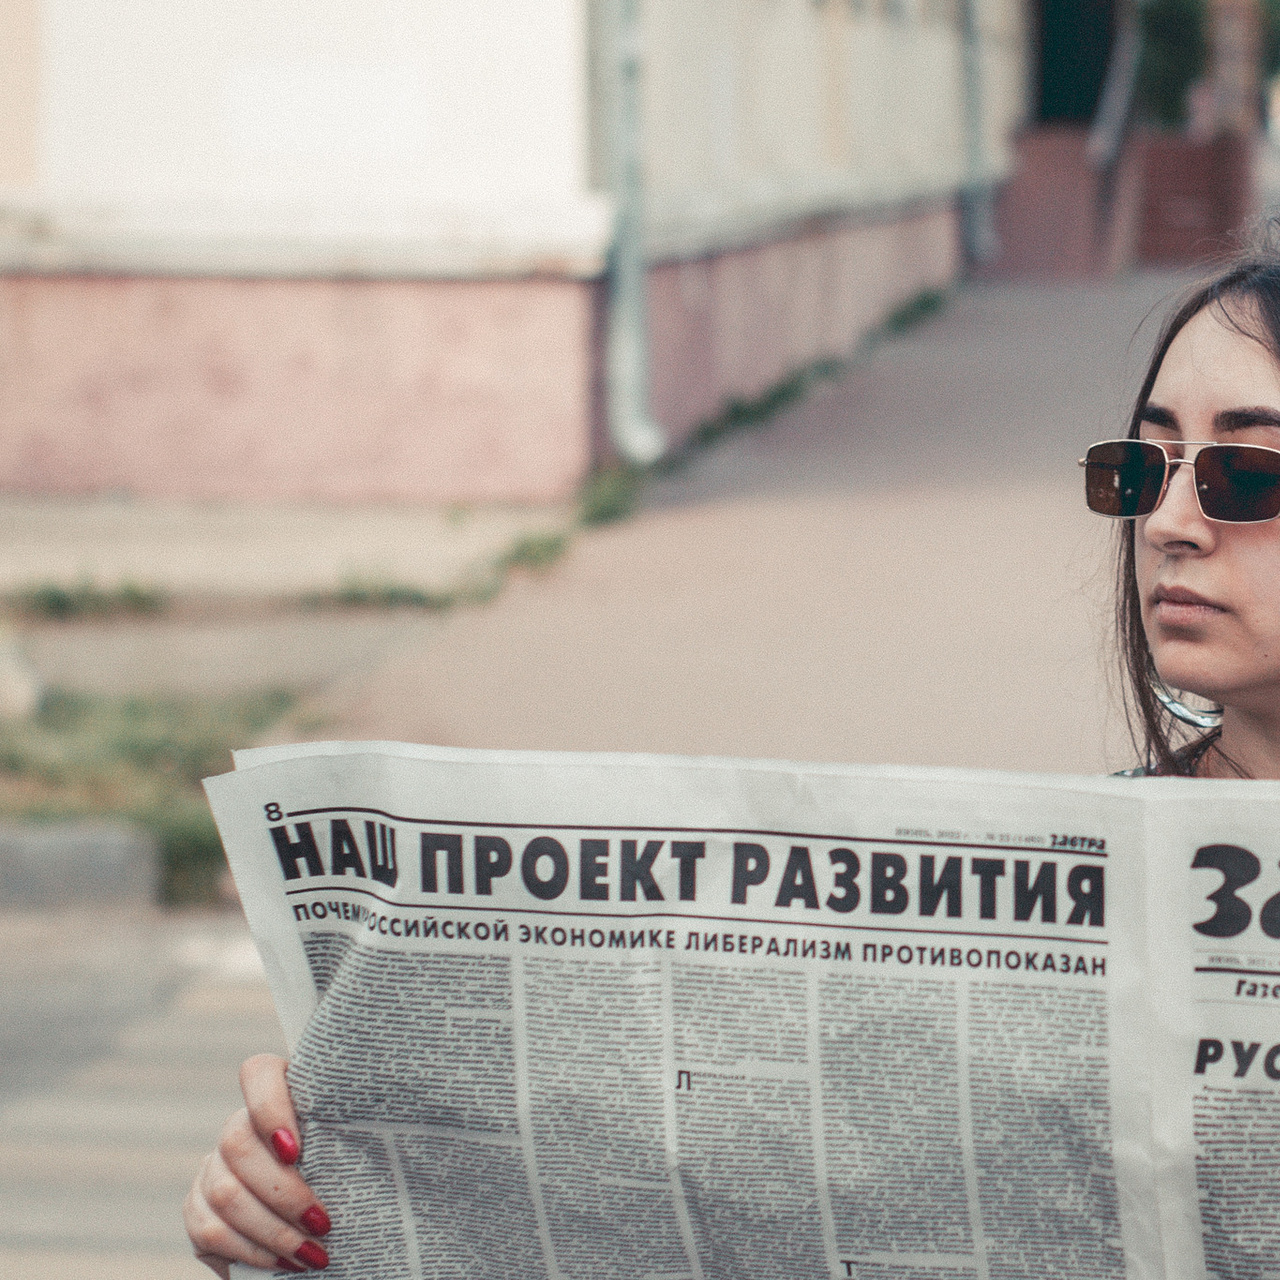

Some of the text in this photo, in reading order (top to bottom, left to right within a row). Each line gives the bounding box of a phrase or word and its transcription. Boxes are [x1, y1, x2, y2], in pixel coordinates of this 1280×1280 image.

[264, 802, 284, 822] 8
[269, 819, 1106, 928] НАШ ПРОЕКТ РАЗВИТИЯ
[368, 911, 510, 942] ОССИЙСКОЙ
[518, 923, 675, 949] ЭКОНОМИКЕ
[684, 931, 852, 962] ЛИБЕРАЛИЗМ
[862, 943, 1106, 977] ПРОТИВОПОКАЗАН
